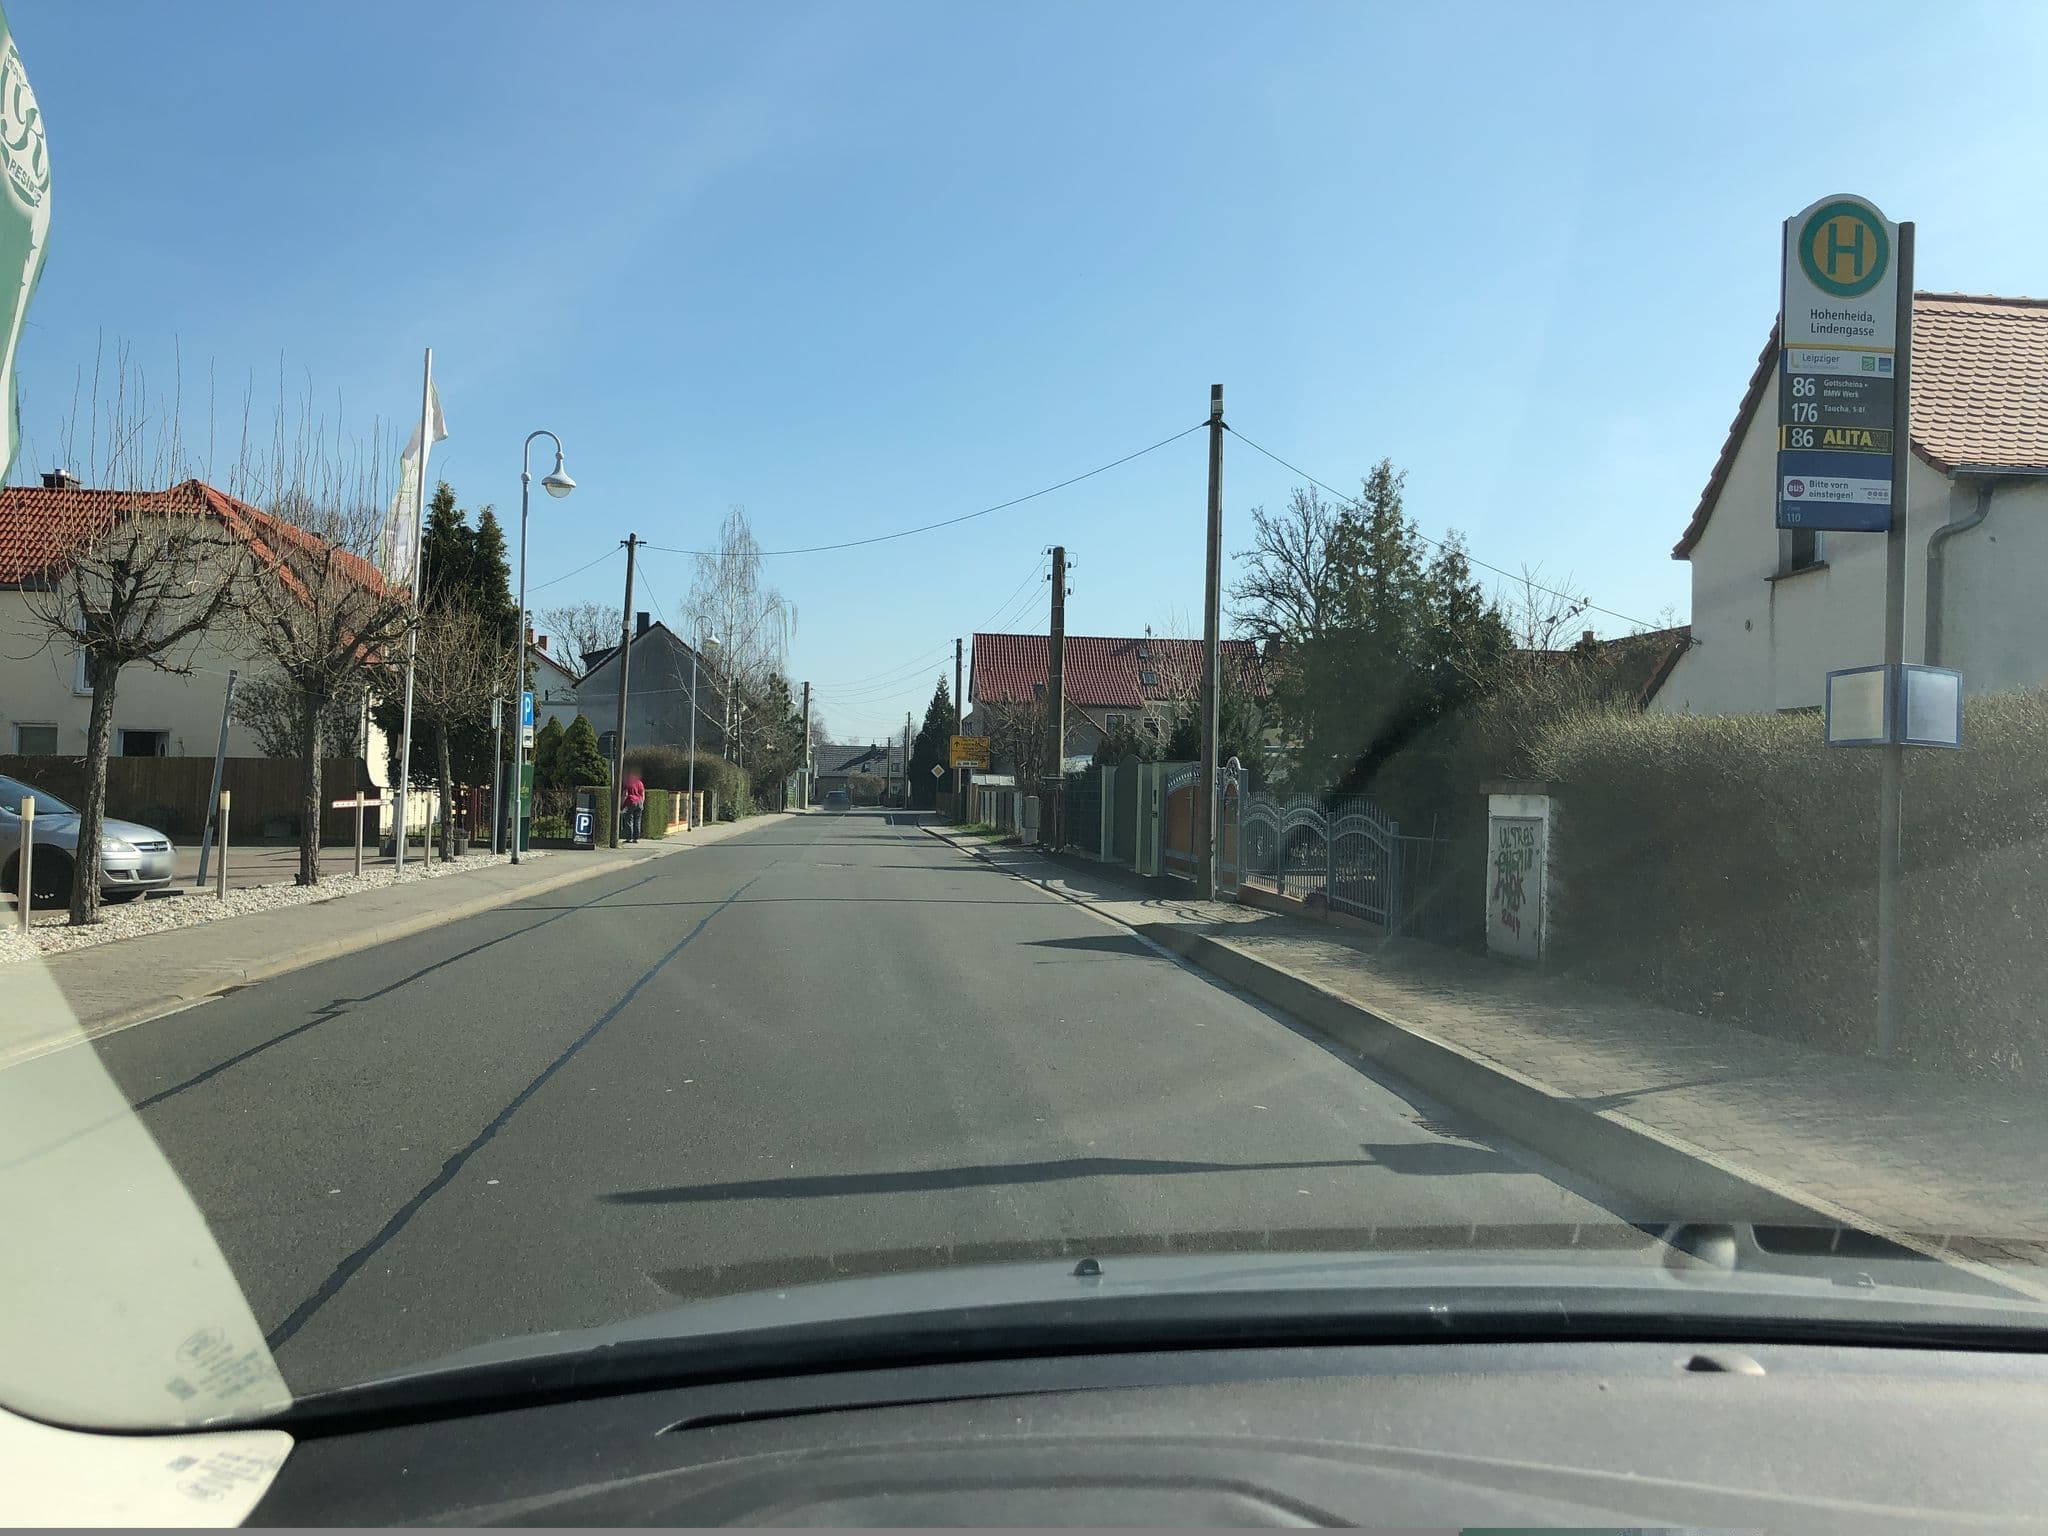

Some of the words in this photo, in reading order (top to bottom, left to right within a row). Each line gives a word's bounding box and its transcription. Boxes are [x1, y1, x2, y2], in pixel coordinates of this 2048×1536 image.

[1827, 222, 1864, 277] H
[1810, 308, 1875, 323] Hohenheida,
[1810, 323, 1875, 337] Lindengasse
[1802, 353, 1840, 365] Leipziger
[1792, 377, 1816, 397] 86
[1791, 402, 1818, 423] 176
[1791, 427, 1814, 448] 86
[1822, 429, 1873, 447] ALITA
[1788, 484, 1804, 492] BUS
[1809, 480, 1829, 488] Bitte
[1809, 490, 1854, 500] einsteigen!
[524, 697, 532, 722] P
[580, 816, 590, 831] P
